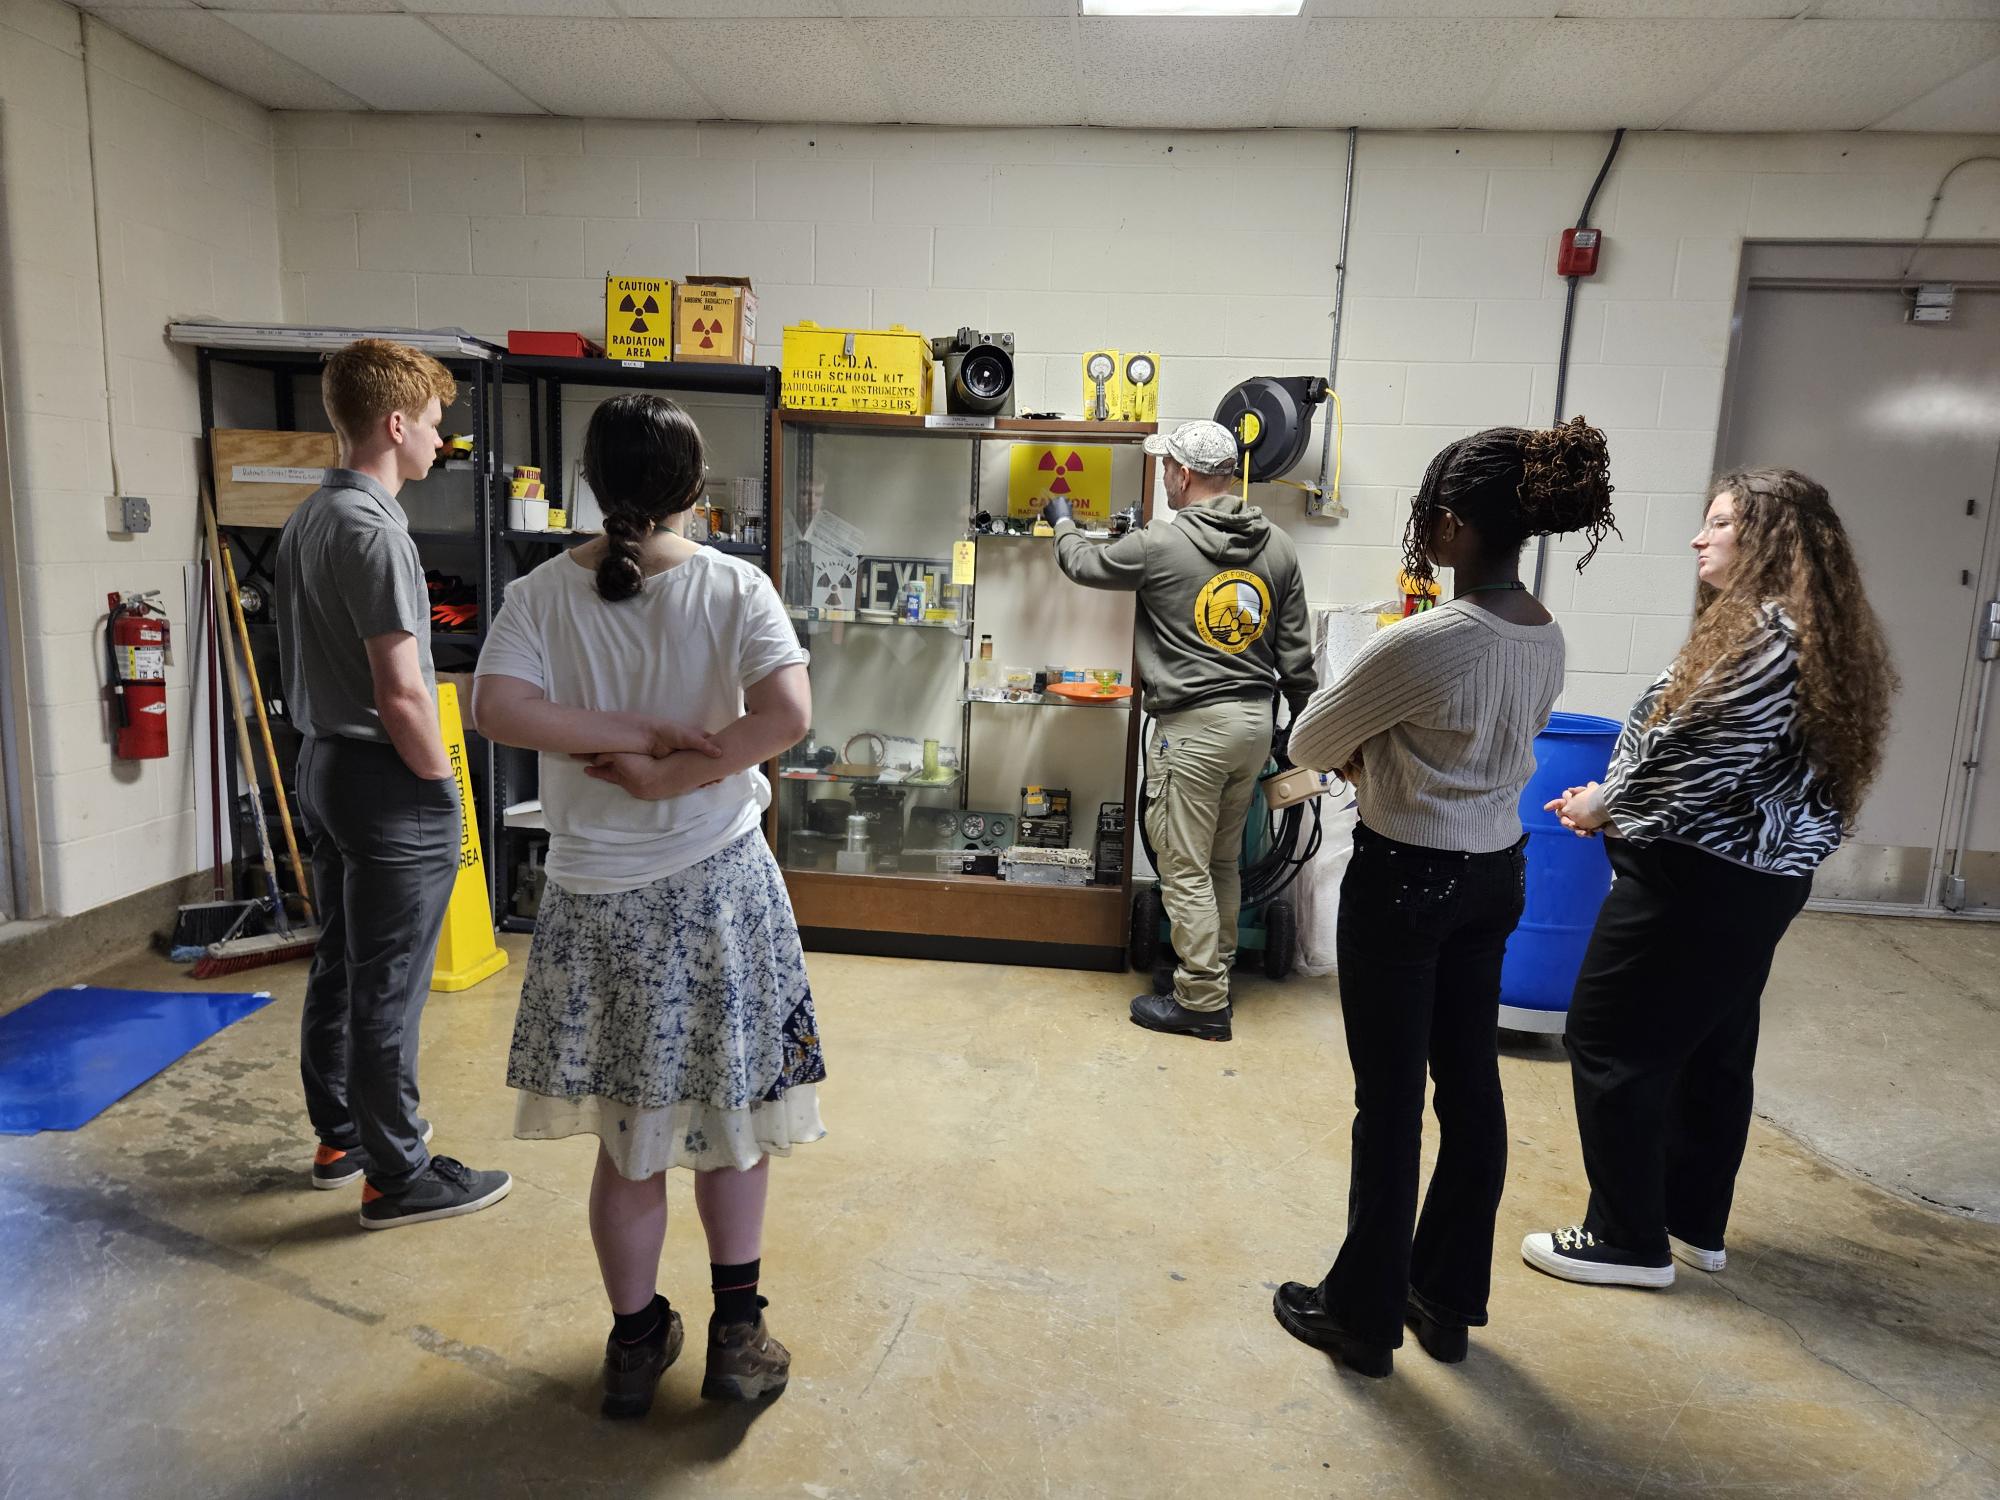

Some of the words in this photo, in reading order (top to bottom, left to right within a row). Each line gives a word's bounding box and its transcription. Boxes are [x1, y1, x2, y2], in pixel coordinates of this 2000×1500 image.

[618, 280, 660, 292] CAUTION
[704, 297, 733, 305] RADIOACTIVITY
[612, 335, 665, 347] RADIATION
[626, 347, 651, 358] AREA
[819, 354, 878, 369] F.C.D.A.
[793, 370, 821, 379] HIGH
[829, 371, 877, 383] SCHOOL
[884, 373, 904, 383] KIT
[852, 386, 915, 397] INSTRUMENTS
[852, 398, 869, 408] WT
[1029, 497, 1090, 509] CAON
[1216, 573, 1229, 582] AIR
[1230, 571, 1254, 580] FORCE
[869, 561, 950, 611] EXIT
[458, 848, 480, 870] REA
